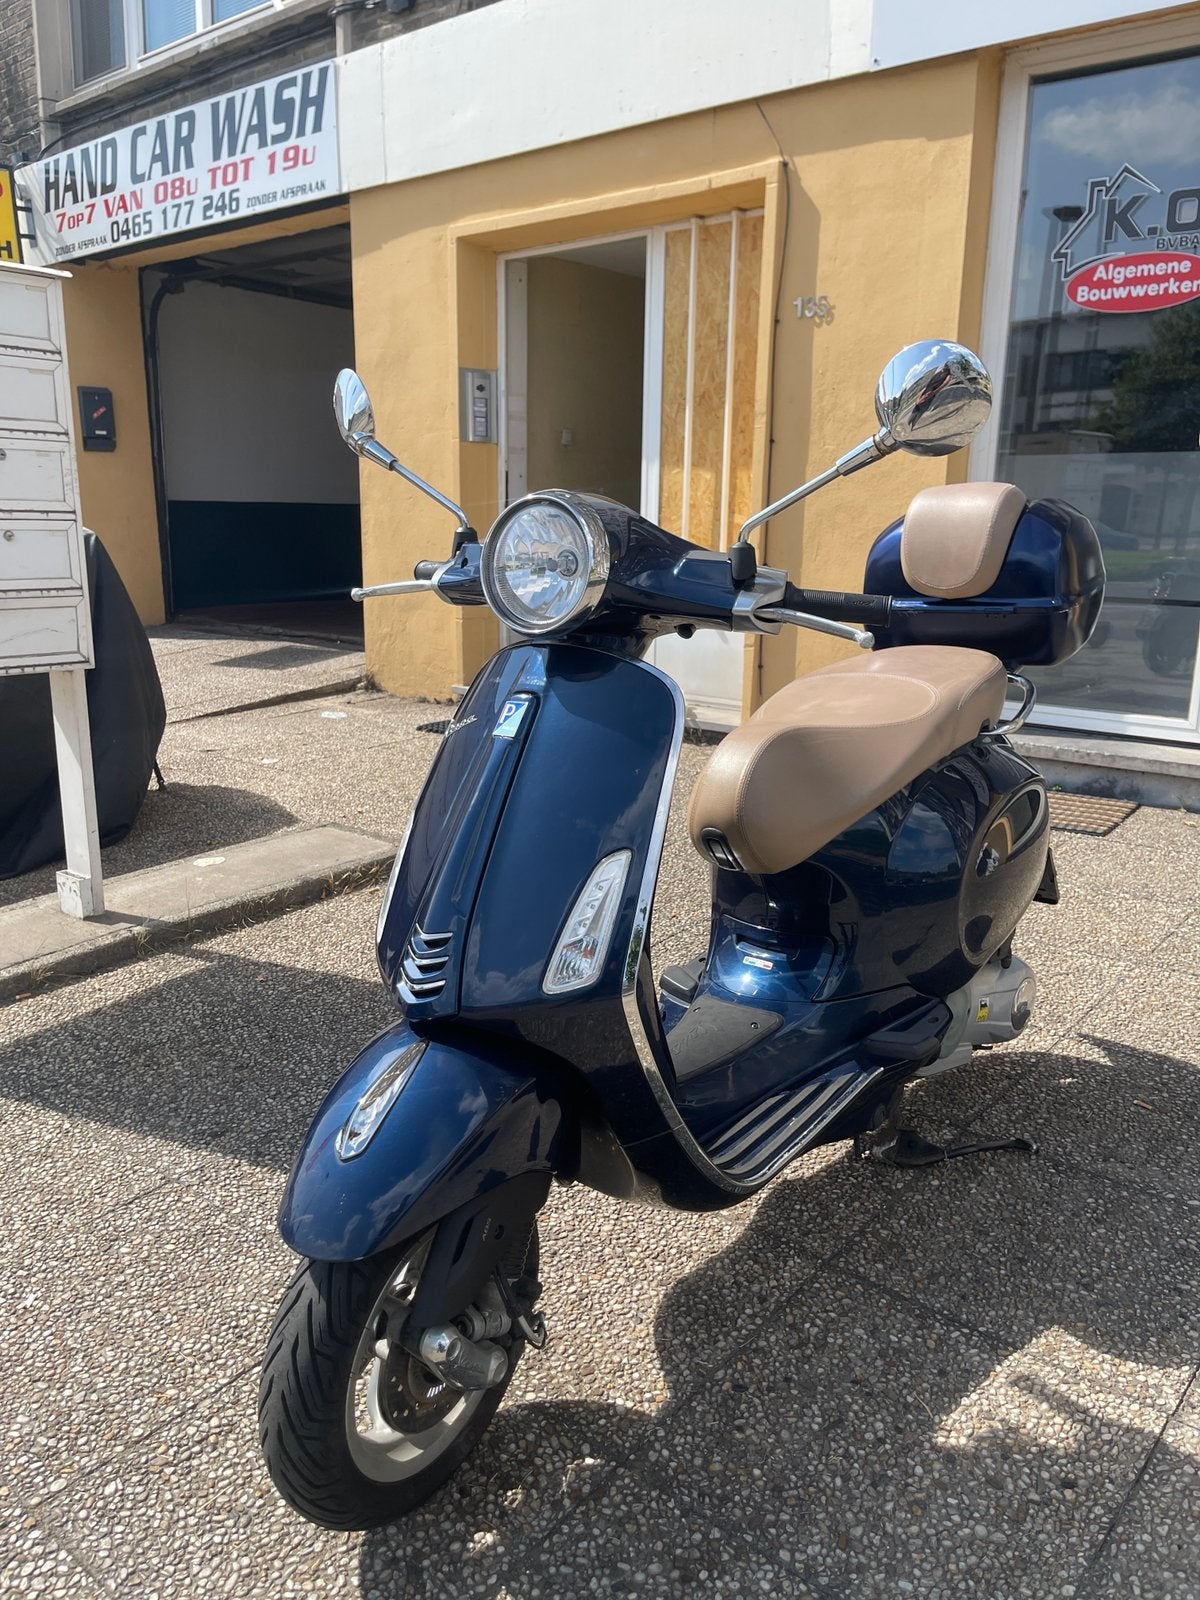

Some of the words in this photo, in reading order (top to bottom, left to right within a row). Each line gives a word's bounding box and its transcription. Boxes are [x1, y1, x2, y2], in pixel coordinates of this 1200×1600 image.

[44, 138, 118, 215] HAND
[130, 110, 196, 185] CAR
[210, 65, 330, 162] WASH
[104, 188, 143, 219] VAN
[207, 157, 255, 190] TOT
[55, 242, 76, 257] ZONDER
[110, 210, 153, 243] 0465
[161, 200, 194, 230] 177
[202, 188, 240, 221] 246
[246, 191, 278, 208] ZONDER
[280, 180, 326, 201] AFSPRAAK
[1156, 233, 1200, 250] BVBA
[1093, 260, 1192, 284] Algemene
[1076, 277, 1200, 302] Bouwwerken
[499, 703, 516, 724] P
